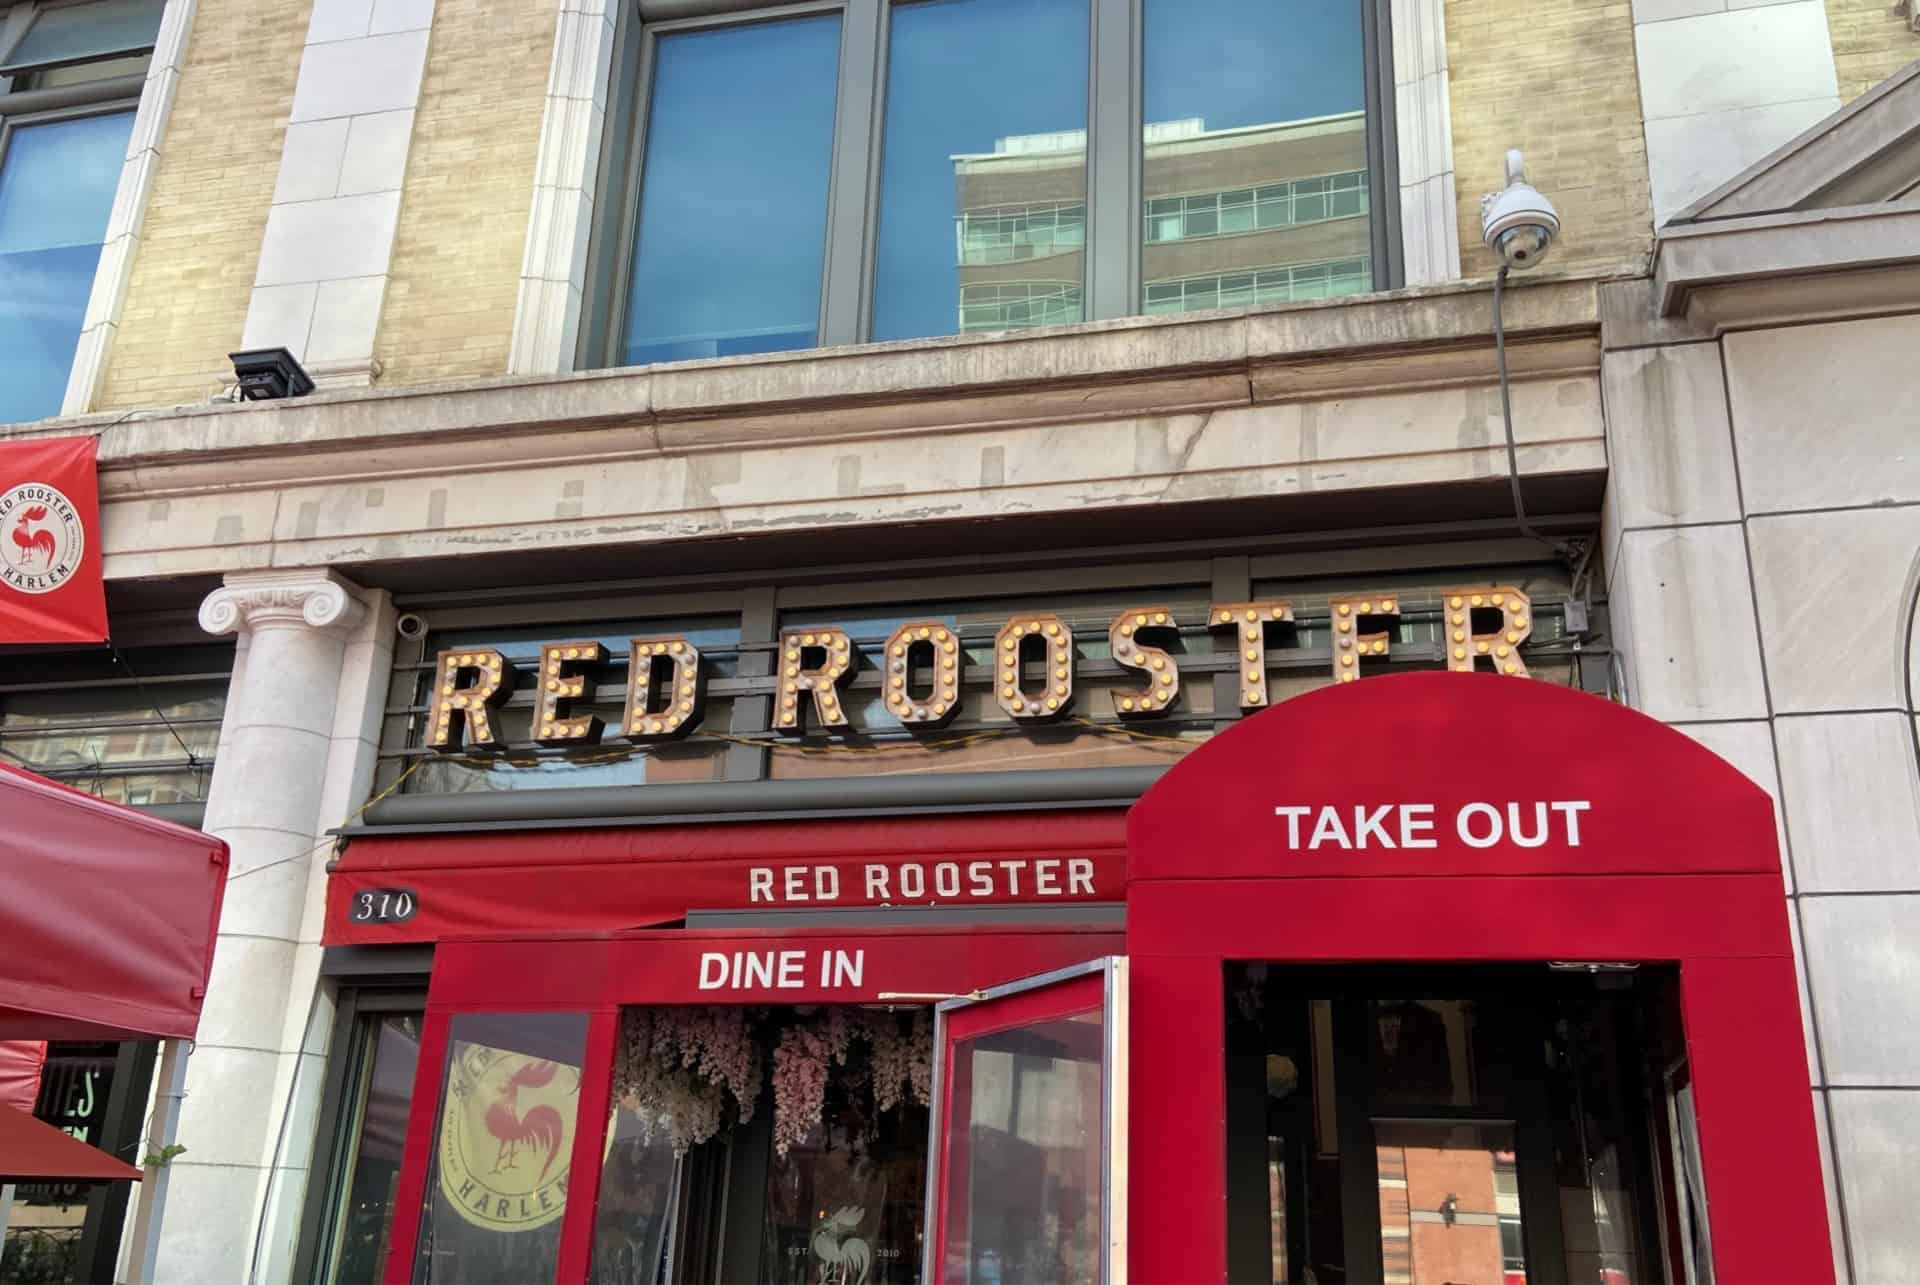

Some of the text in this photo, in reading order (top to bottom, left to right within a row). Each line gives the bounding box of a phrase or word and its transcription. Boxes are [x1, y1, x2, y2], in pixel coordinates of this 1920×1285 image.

[18, 488, 73, 522] ROOSTER
[4, 565, 69, 588] HARLEM
[426, 586, 1534, 751] RED ROOSTER
[1275, 800, 1591, 849] TAKE OUT
[750, 858, 1096, 902] RED ROOSTER
[357, 892, 412, 919] 310
[699, 950, 865, 990] DINE IN
[877, 1249, 900, 1257] 2010
